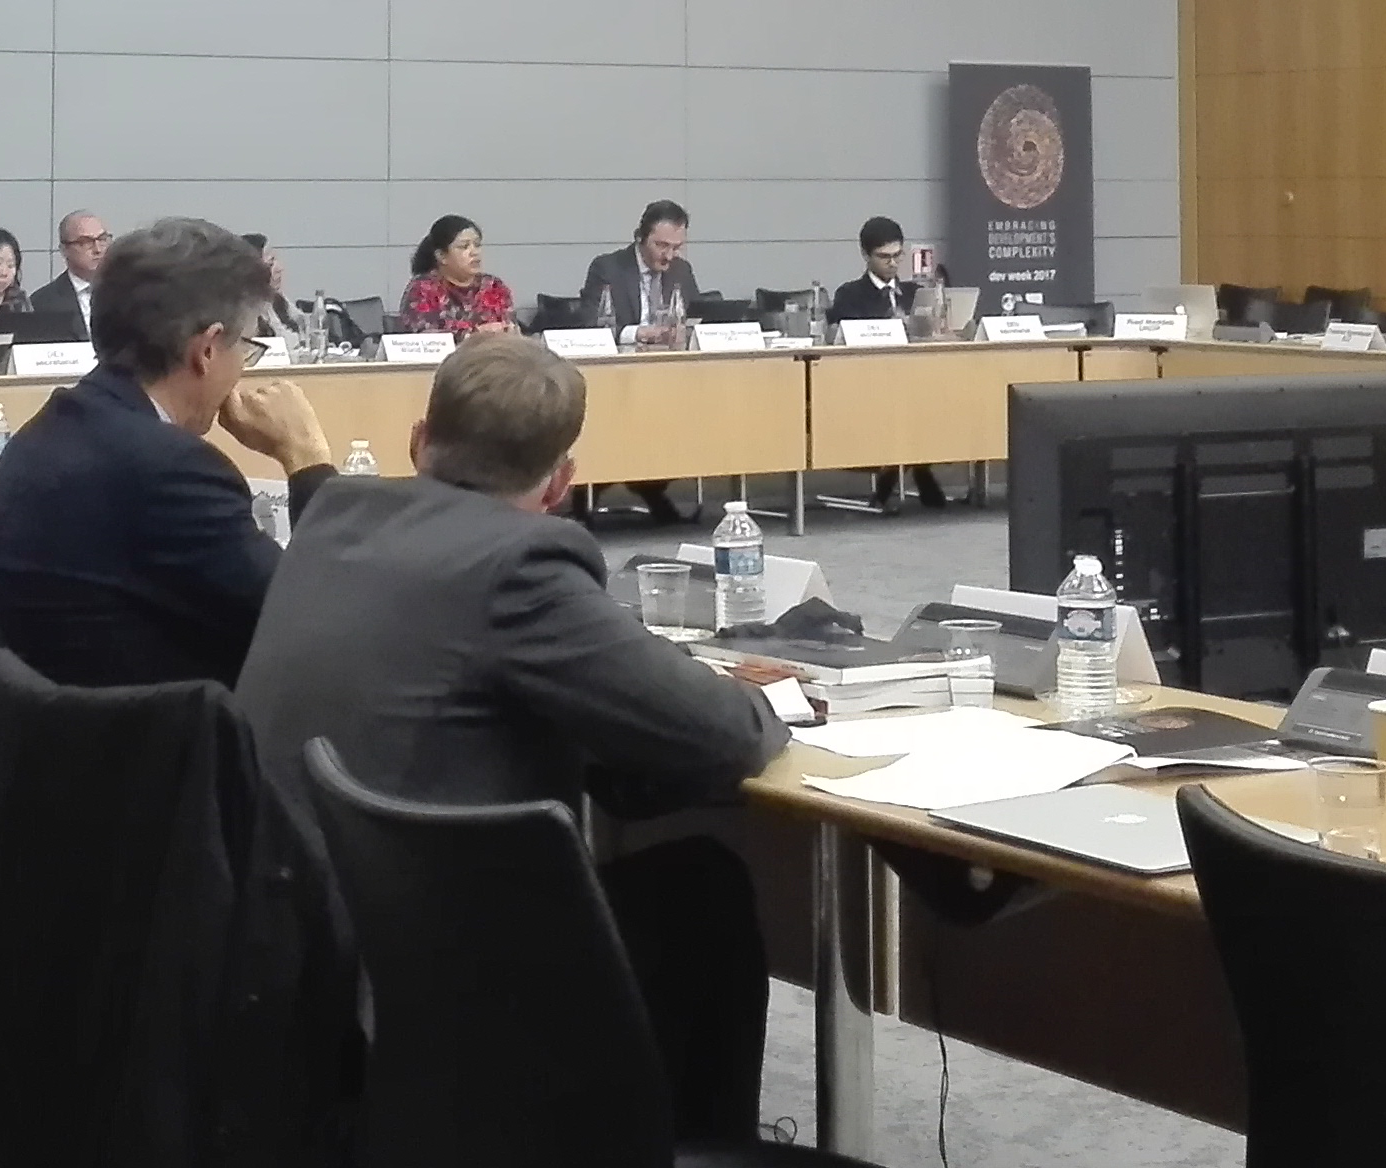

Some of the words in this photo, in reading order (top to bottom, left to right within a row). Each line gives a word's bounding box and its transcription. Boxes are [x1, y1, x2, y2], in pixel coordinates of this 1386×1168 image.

[987, 220, 1056, 231] EMBRACING
[988, 245, 1056, 259] COMPLEXITY
[1033, 269, 1056, 281] 2017
